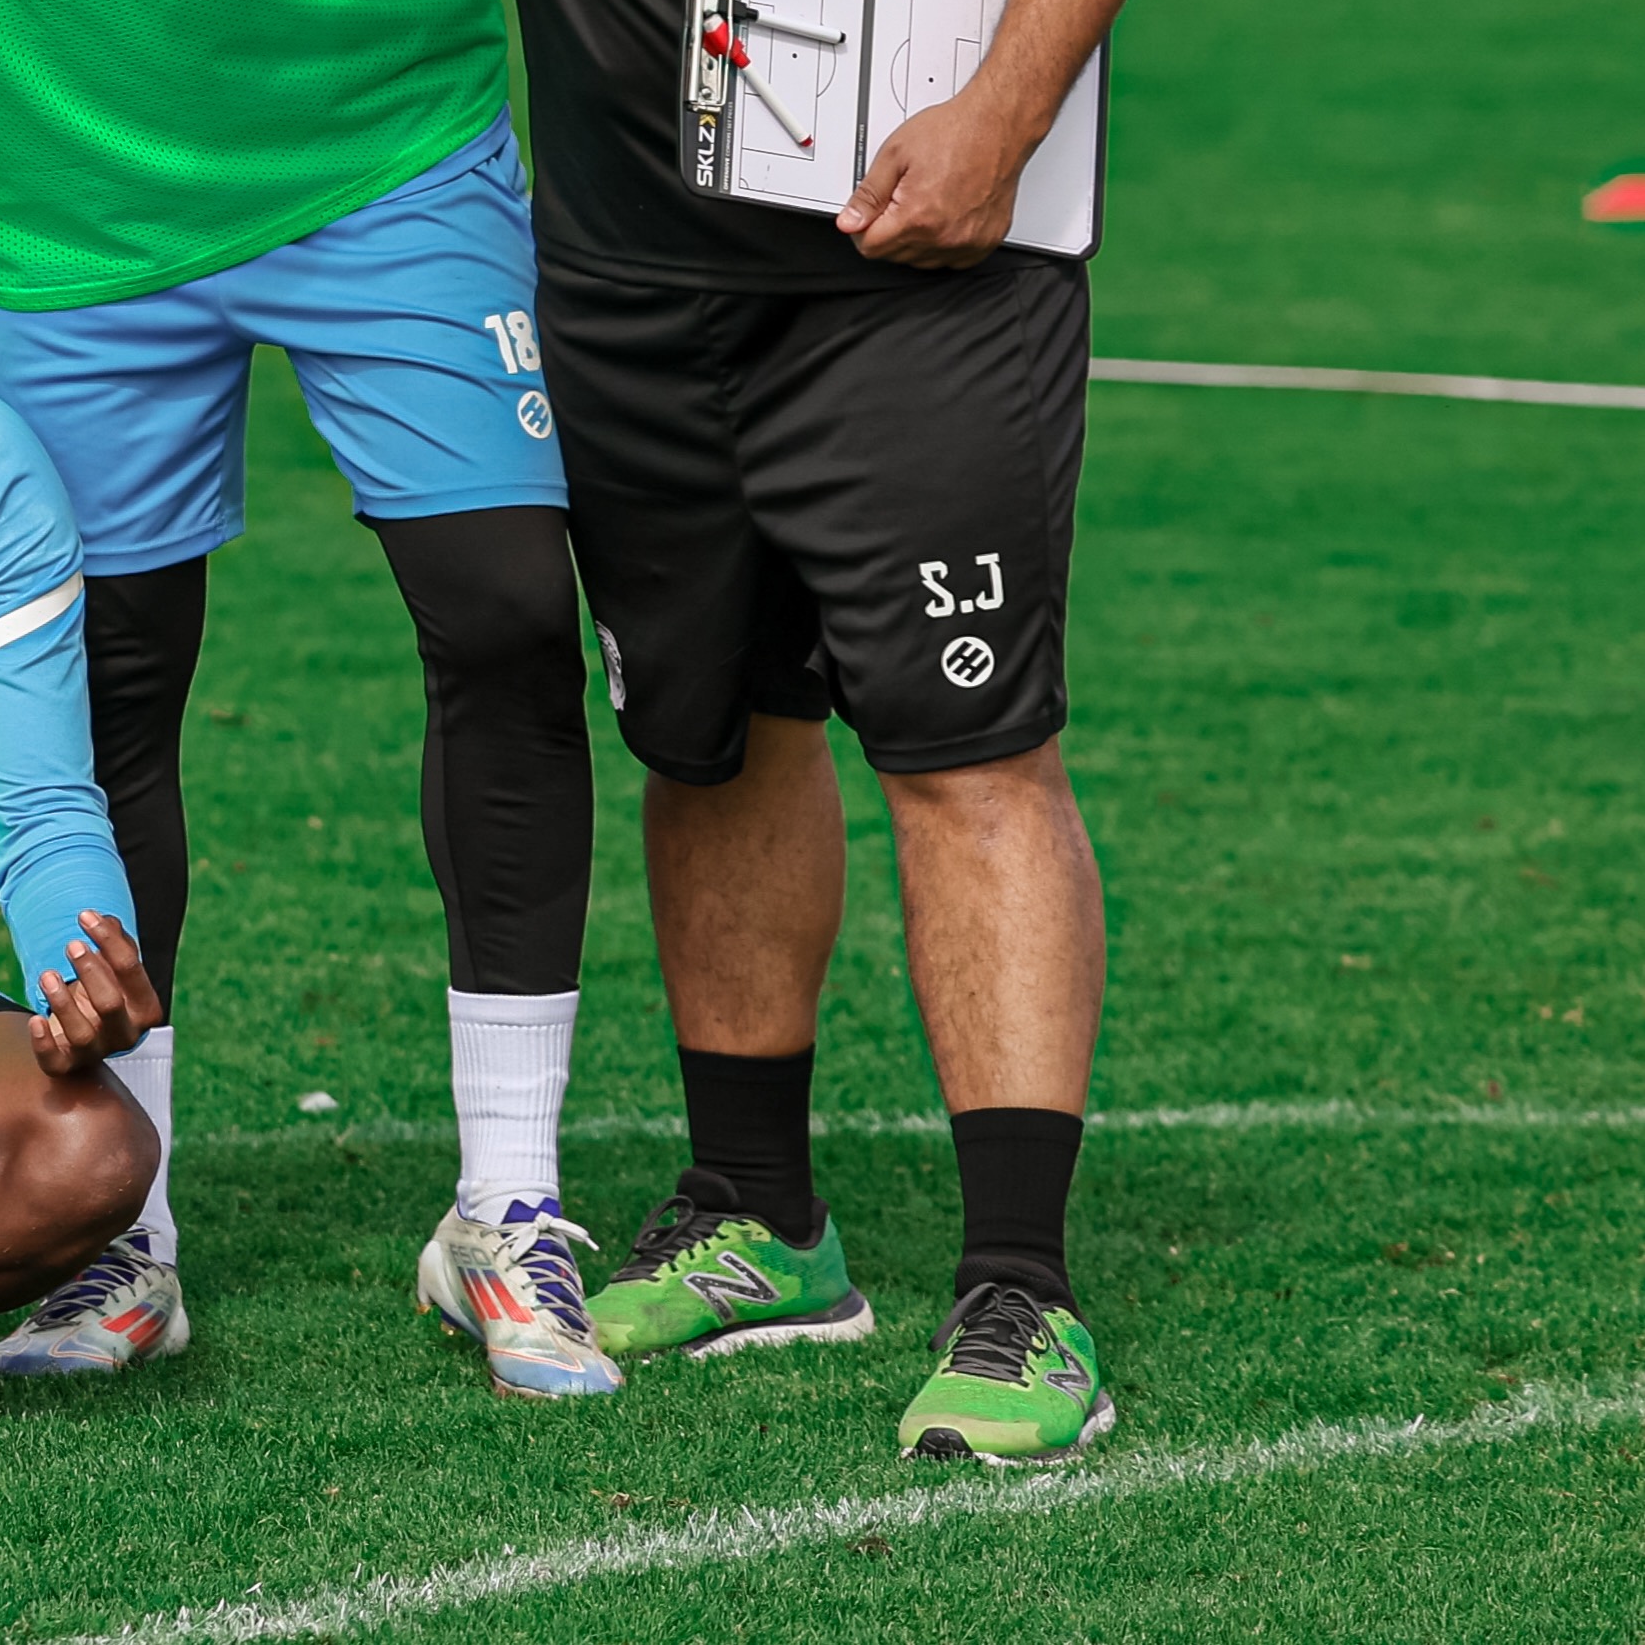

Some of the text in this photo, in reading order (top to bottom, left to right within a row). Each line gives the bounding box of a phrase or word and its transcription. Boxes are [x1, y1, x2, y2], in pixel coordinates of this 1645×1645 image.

[696, 125, 716, 187] SKLZ
[484, 310, 542, 374] 18
[918, 552, 1005, 617] S.J
